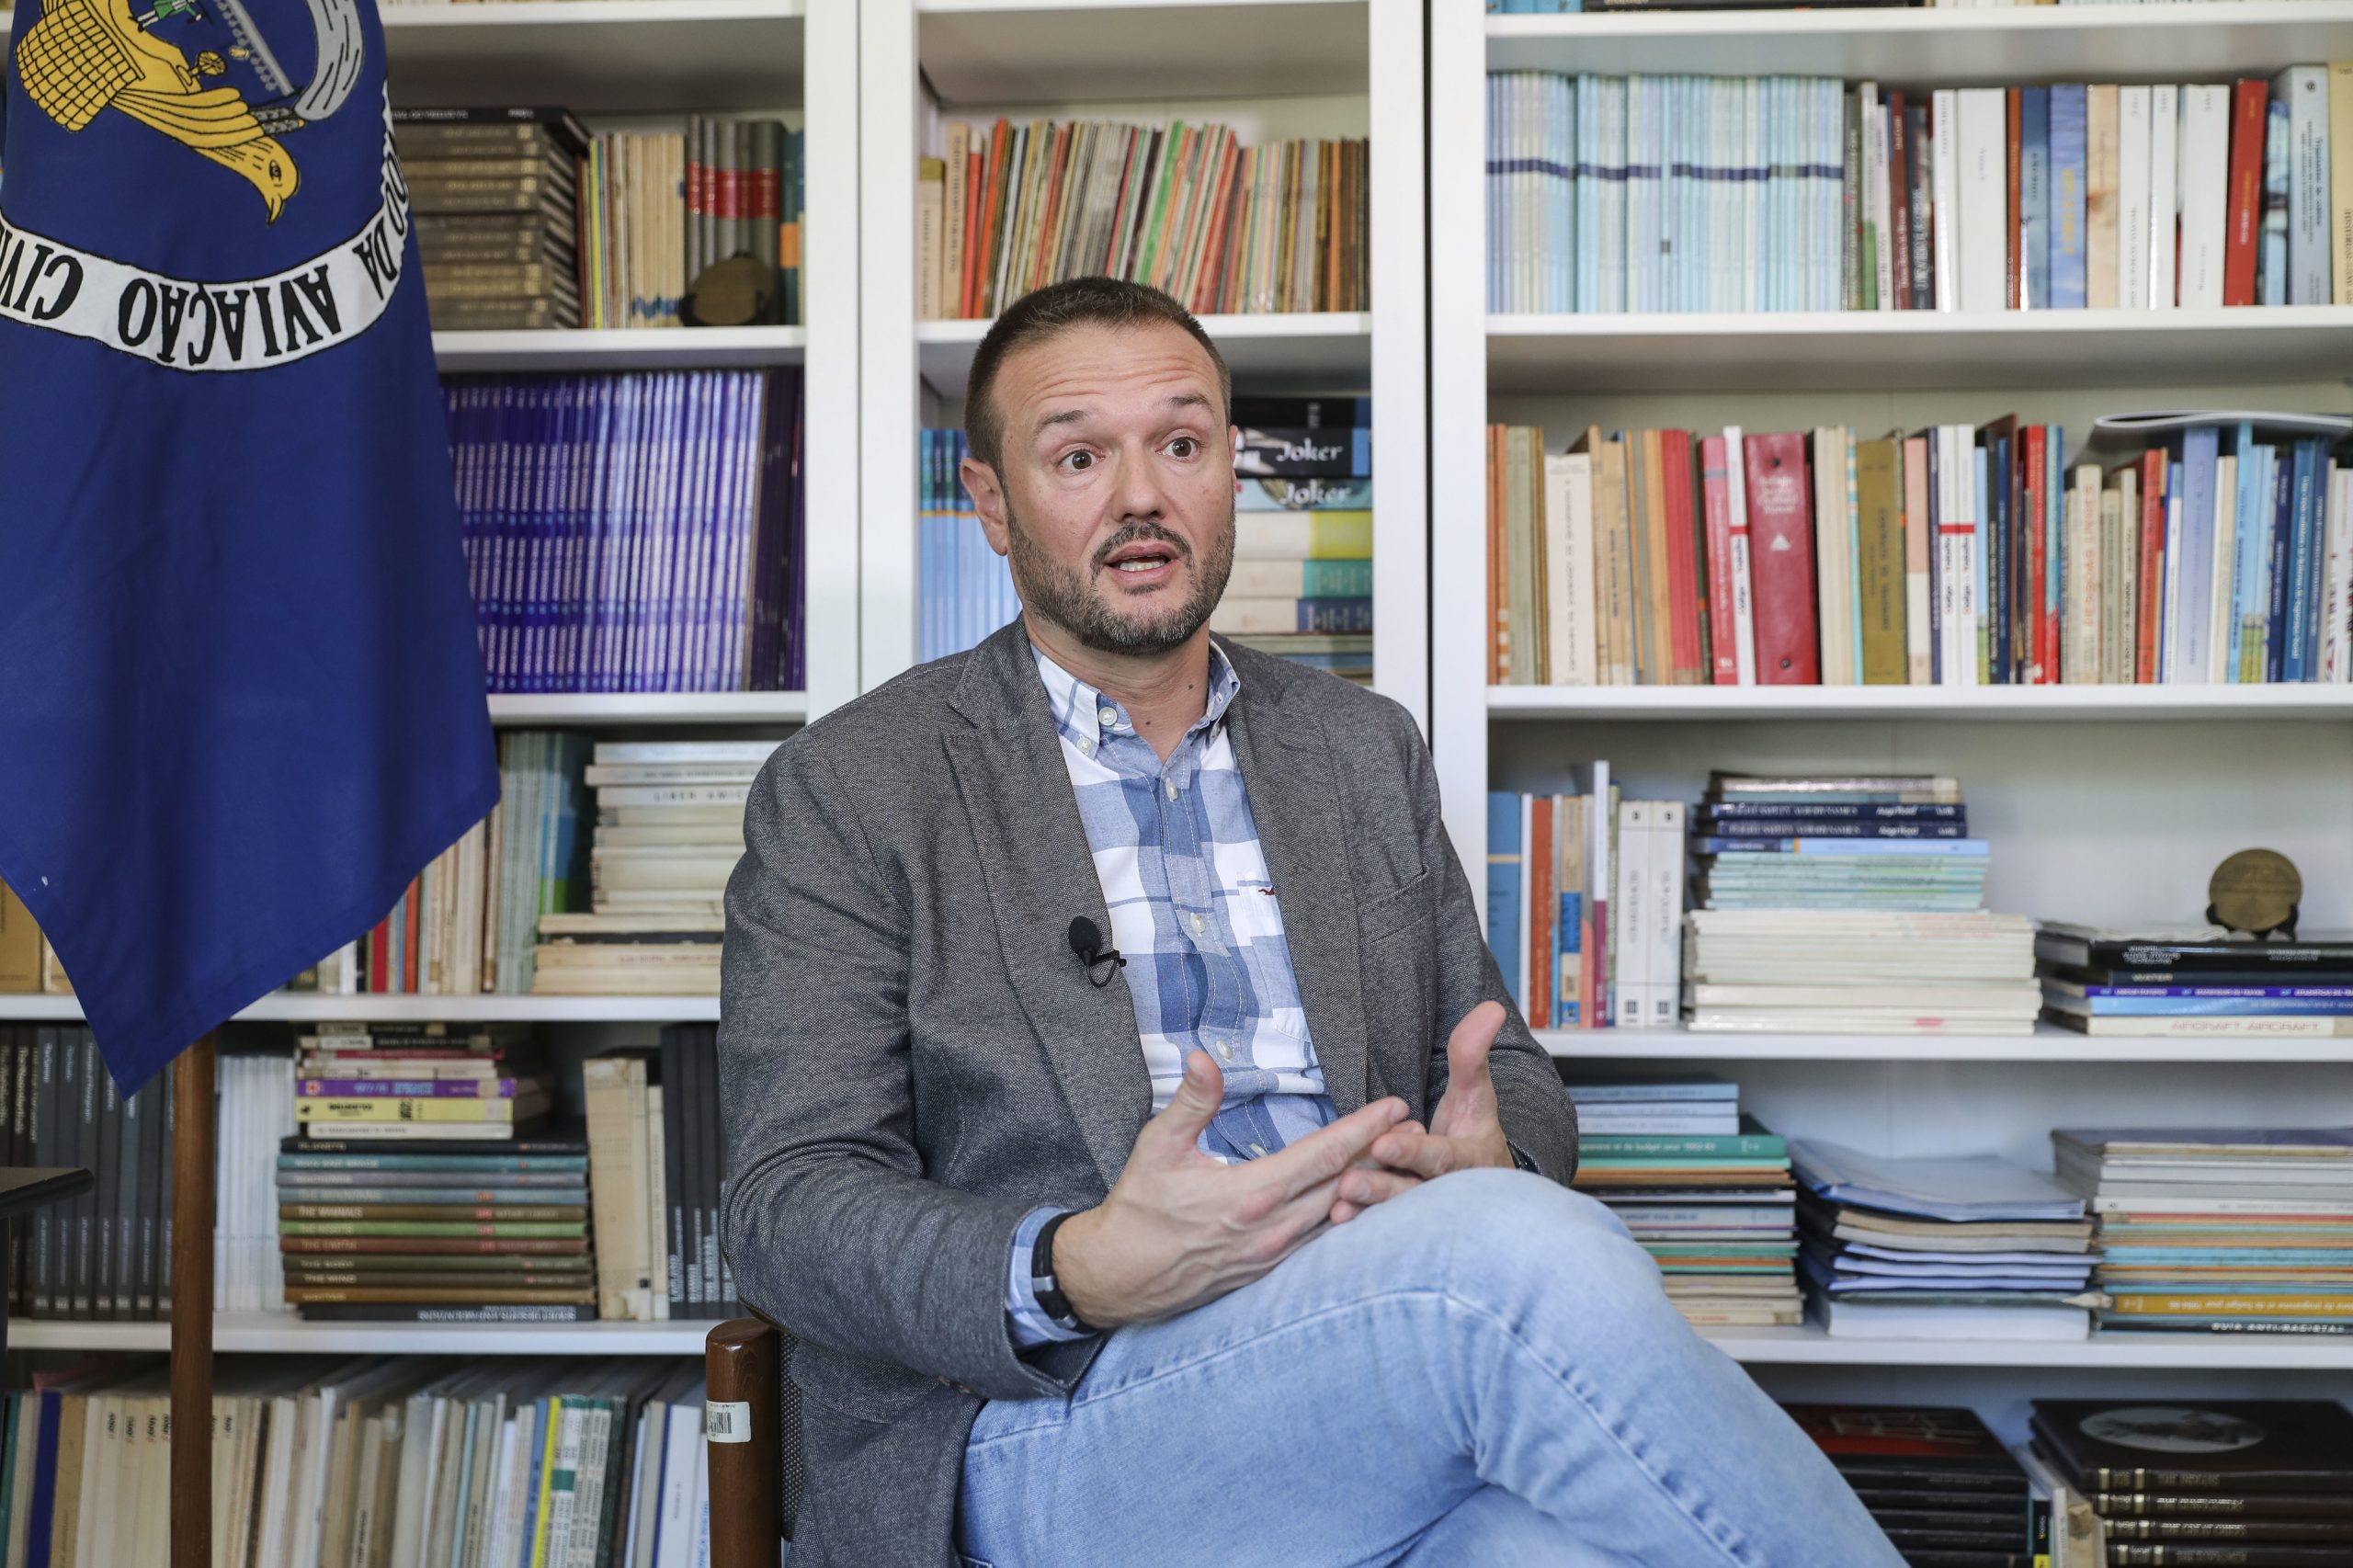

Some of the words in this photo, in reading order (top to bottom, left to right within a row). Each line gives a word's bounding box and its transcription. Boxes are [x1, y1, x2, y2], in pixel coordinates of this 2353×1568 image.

[353, 232, 399, 301] DA
[117, 263, 343, 367] AVIAÇÃO
[1276, 437, 1344, 462] Joker
[1279, 478, 1352, 506] Joker
[2083, 483, 2097, 544] LIVRES
[2083, 549, 2097, 628] PESSOAS
[2171, 1021, 2241, 1031] AIRCRAFT
[2247, 1021, 2321, 1032] AIRCRAFT
[2211, 1322, 2243, 1332] GUIA
